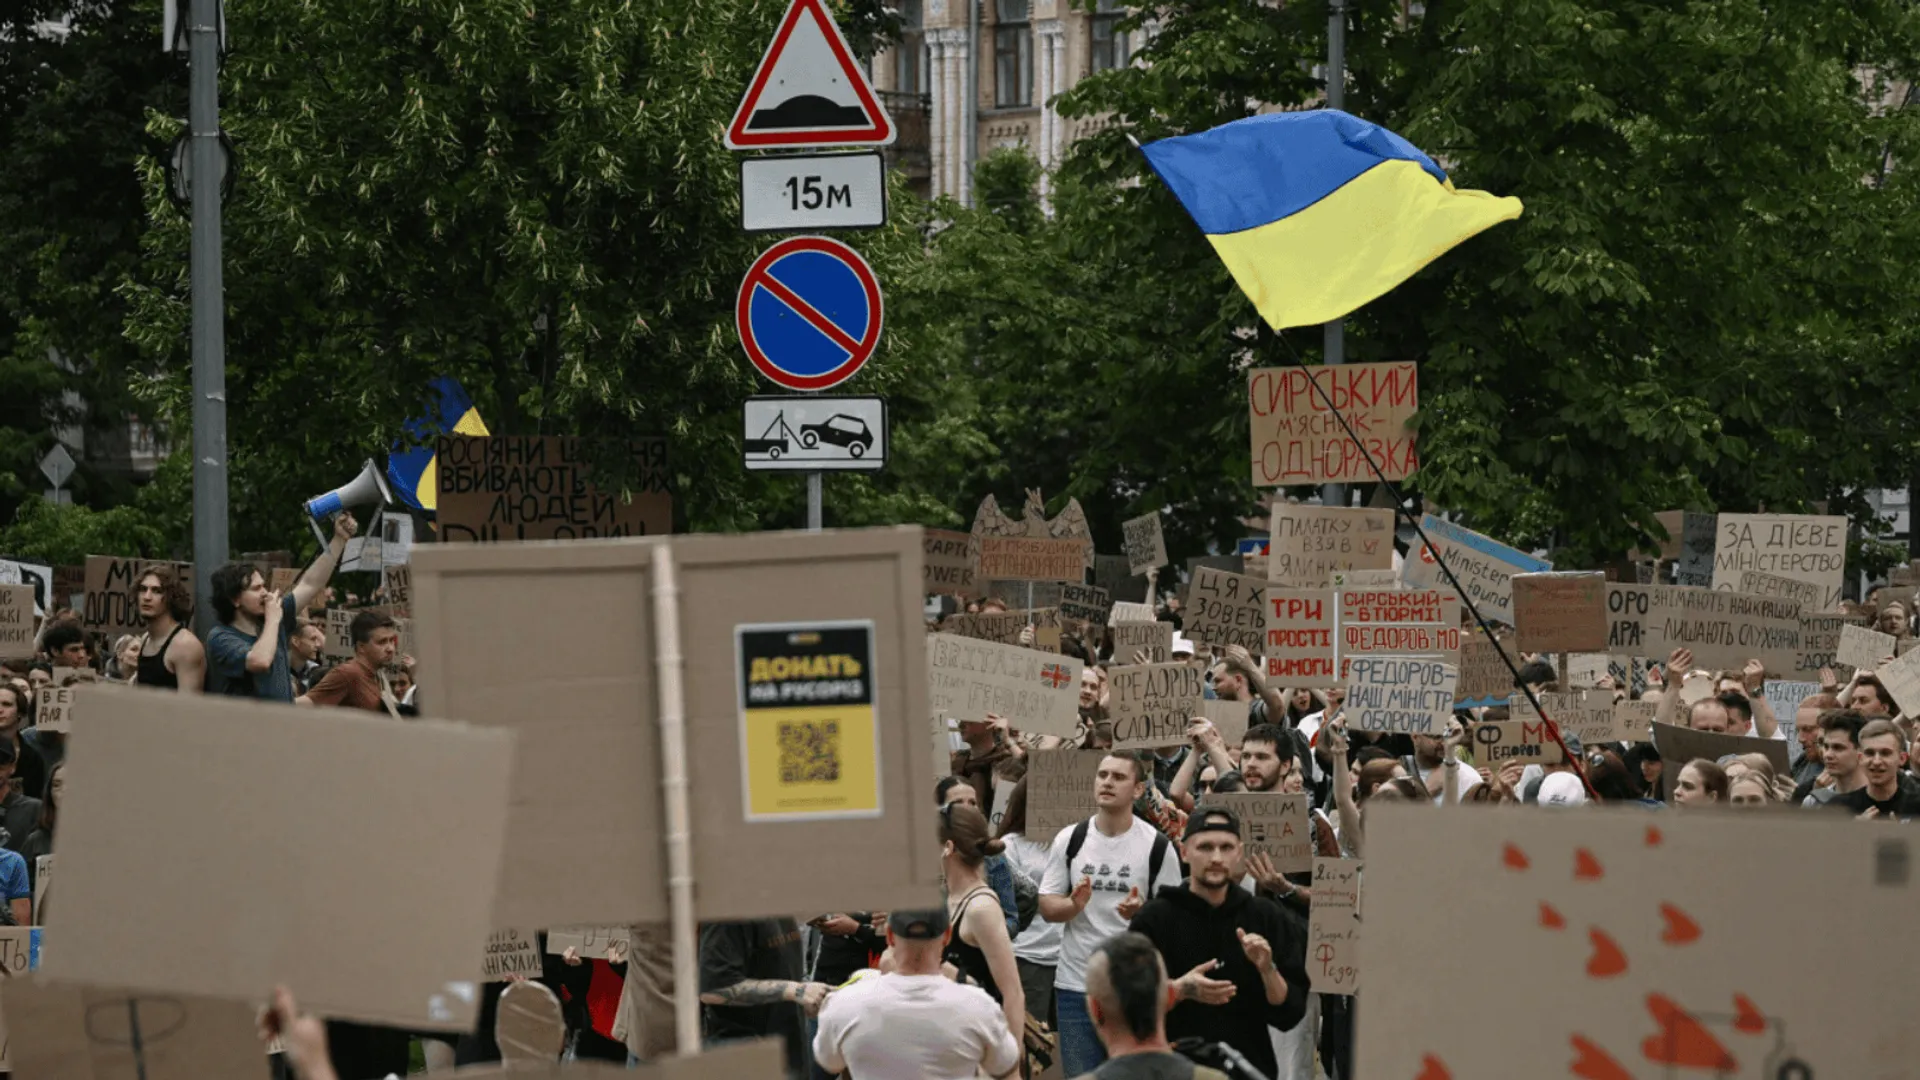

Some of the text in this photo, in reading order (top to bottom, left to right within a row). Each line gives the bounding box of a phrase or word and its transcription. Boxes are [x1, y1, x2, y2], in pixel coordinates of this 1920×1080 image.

[1251, 364, 1416, 416] СИРСЬКИЙ
[437, 436, 545, 467] РОСІЯНИ
[440, 465, 588, 495] ВБИВАЮТЬ
[489, 495, 616, 525] ЛЮДЕЙ
[1279, 516, 1353, 538] ПАЛАТКУ
[1724, 521, 1839, 549] ЗА ДІЄВЕ
[1443, 546, 1510, 586] Minister
[1715, 549, 1843, 572] МІНІСТЕРСТВО
[1201, 574, 1240, 599] ЦЯ
[1466, 578, 1512, 609] found
[1270, 599, 1323, 621] ТРИ
[1651, 588, 1725, 613] ЗНІМАЮТЬ
[1729, 597, 1801, 621] НАЙКРАЩИХ
[1267, 628, 1331, 648] ПРОСТІ
[750, 654, 862, 682] ДОНАТЬ
[933, 637, 1038, 682] BRITAIN
[1268, 655, 1334, 678] ВИМОГИ
[1113, 668, 1201, 701] ФЕДОРОВ
[1348, 685, 1383, 709] НАШ
[1113, 710, 1197, 742] СЛОНЯР
[1361, 710, 1433, 733] ОБОРОНИ
